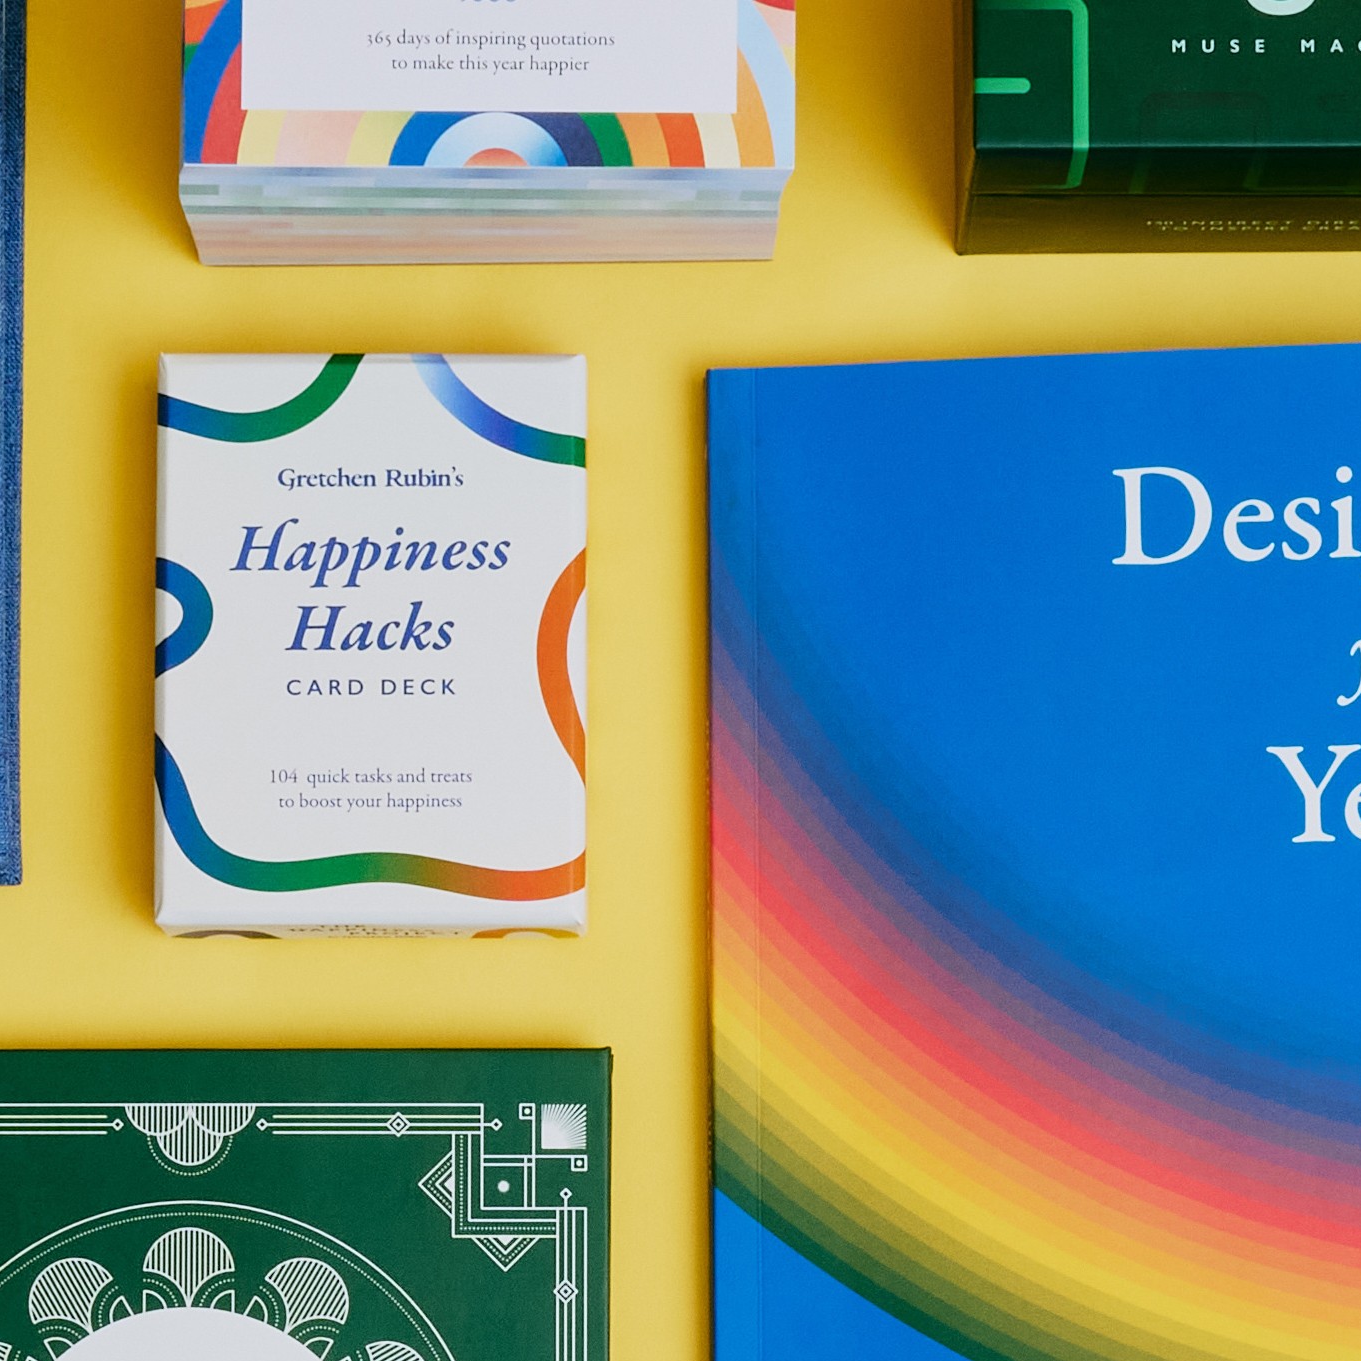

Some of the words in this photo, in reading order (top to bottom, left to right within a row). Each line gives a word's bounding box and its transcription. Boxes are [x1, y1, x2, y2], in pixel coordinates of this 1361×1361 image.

[368, 32, 391, 46] 365
[397, 29, 430, 49] days
[435, 29, 453, 44] of
[457, 31, 526, 50] inspiring
[530, 32, 614, 50] quotations
[1172, 39, 1264, 53] MUSE
[392, 58, 407, 69] to
[414, 54, 454, 69] make
[460, 55, 487, 69] this
[493, 61, 524, 75] year
[531, 55, 589, 75] happier
[278, 468, 376, 490] Gretchen
[386, 467, 463, 486] Rubin's
[229, 518, 510, 588] Happiness
[285, 601, 454, 650] Hacks
[287, 680, 363, 695] CARD
[382, 679, 455, 695] DECK
[272, 770, 297, 783] 104
[307, 768, 349, 788] quick
[355, 768, 392, 783] tasks
[398, 768, 425, 782] and
[431, 771, 472, 783] treats
[279, 796, 294, 808] to
[300, 793, 341, 807] boost
[347, 799, 382, 812] your
[387, 793, 462, 812] happiness
